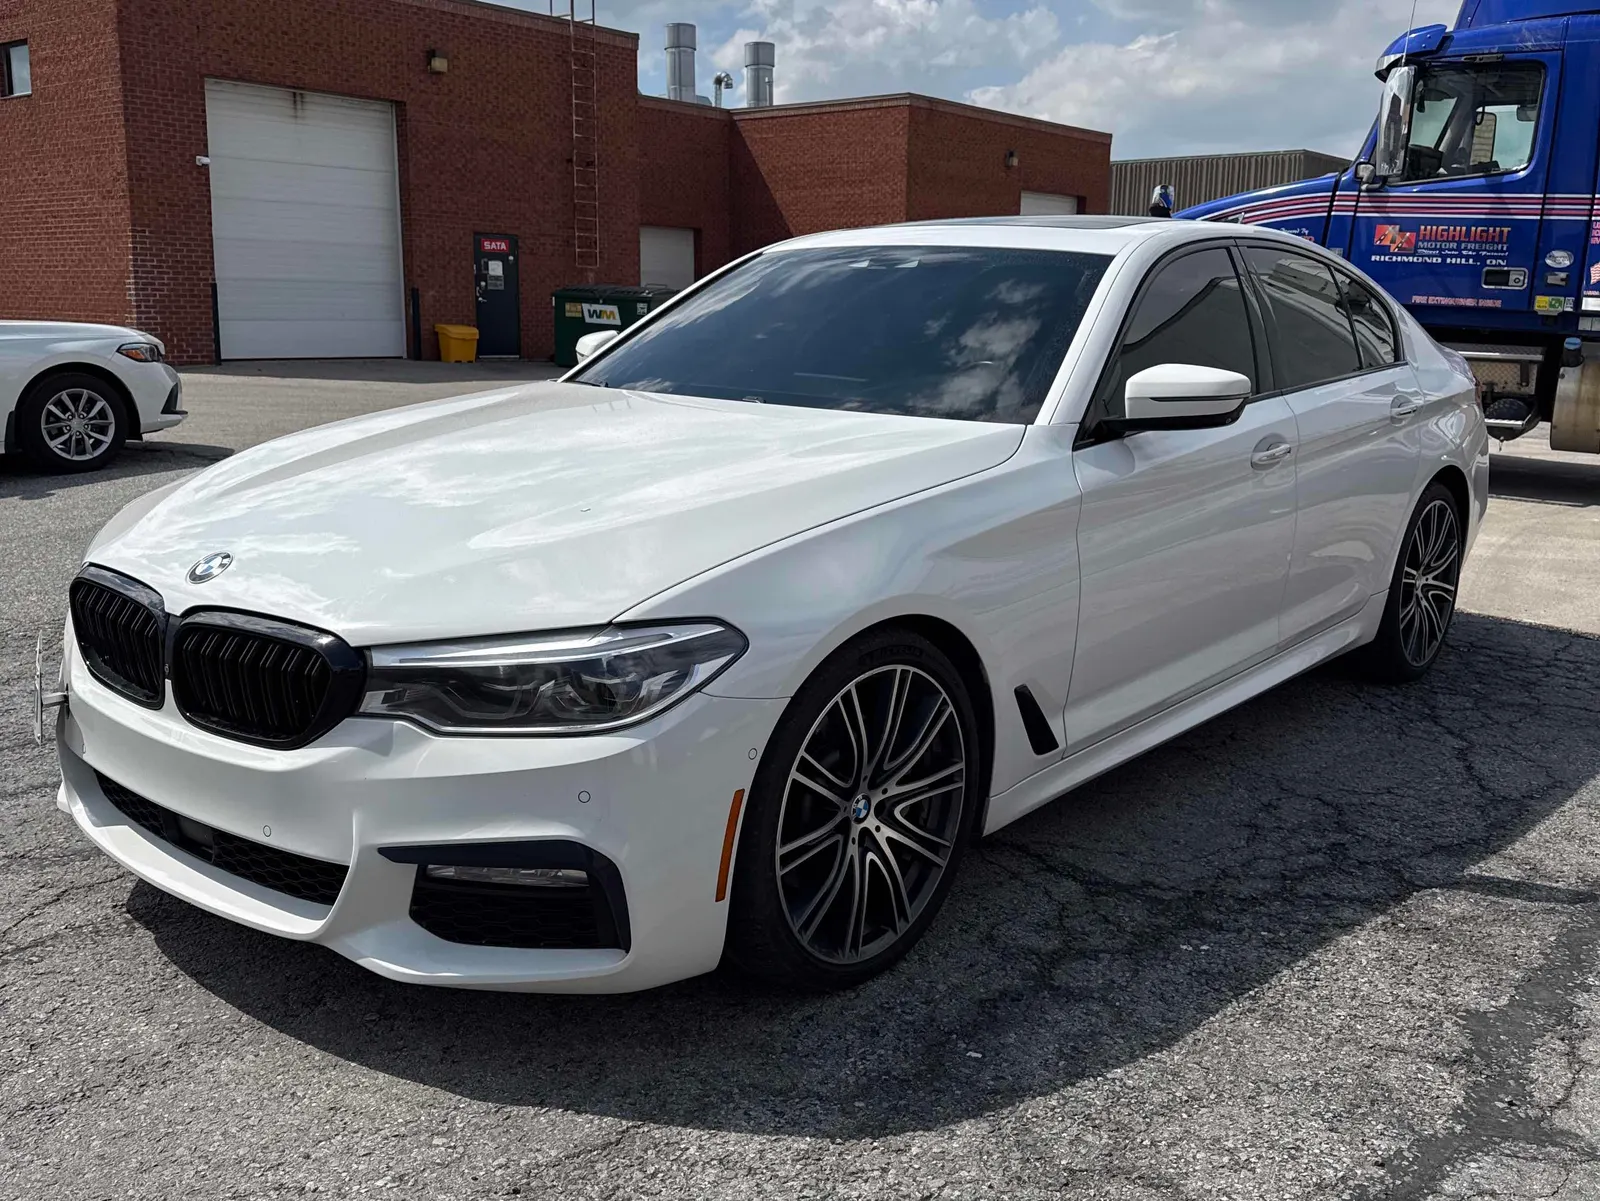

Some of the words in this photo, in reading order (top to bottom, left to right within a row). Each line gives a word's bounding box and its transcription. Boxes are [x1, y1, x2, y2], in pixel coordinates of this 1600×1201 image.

[1419, 225, 1512, 243] HIGHLIGHT
[483, 241, 507, 250] SATA
[1417, 241, 1457, 249] MOTOR
[1461, 242, 1509, 251] FREIGHT
[1371, 255, 1442, 264] RICHMOND
[1446, 257, 1481, 266] HILL,
[587, 308, 617, 320] WM
